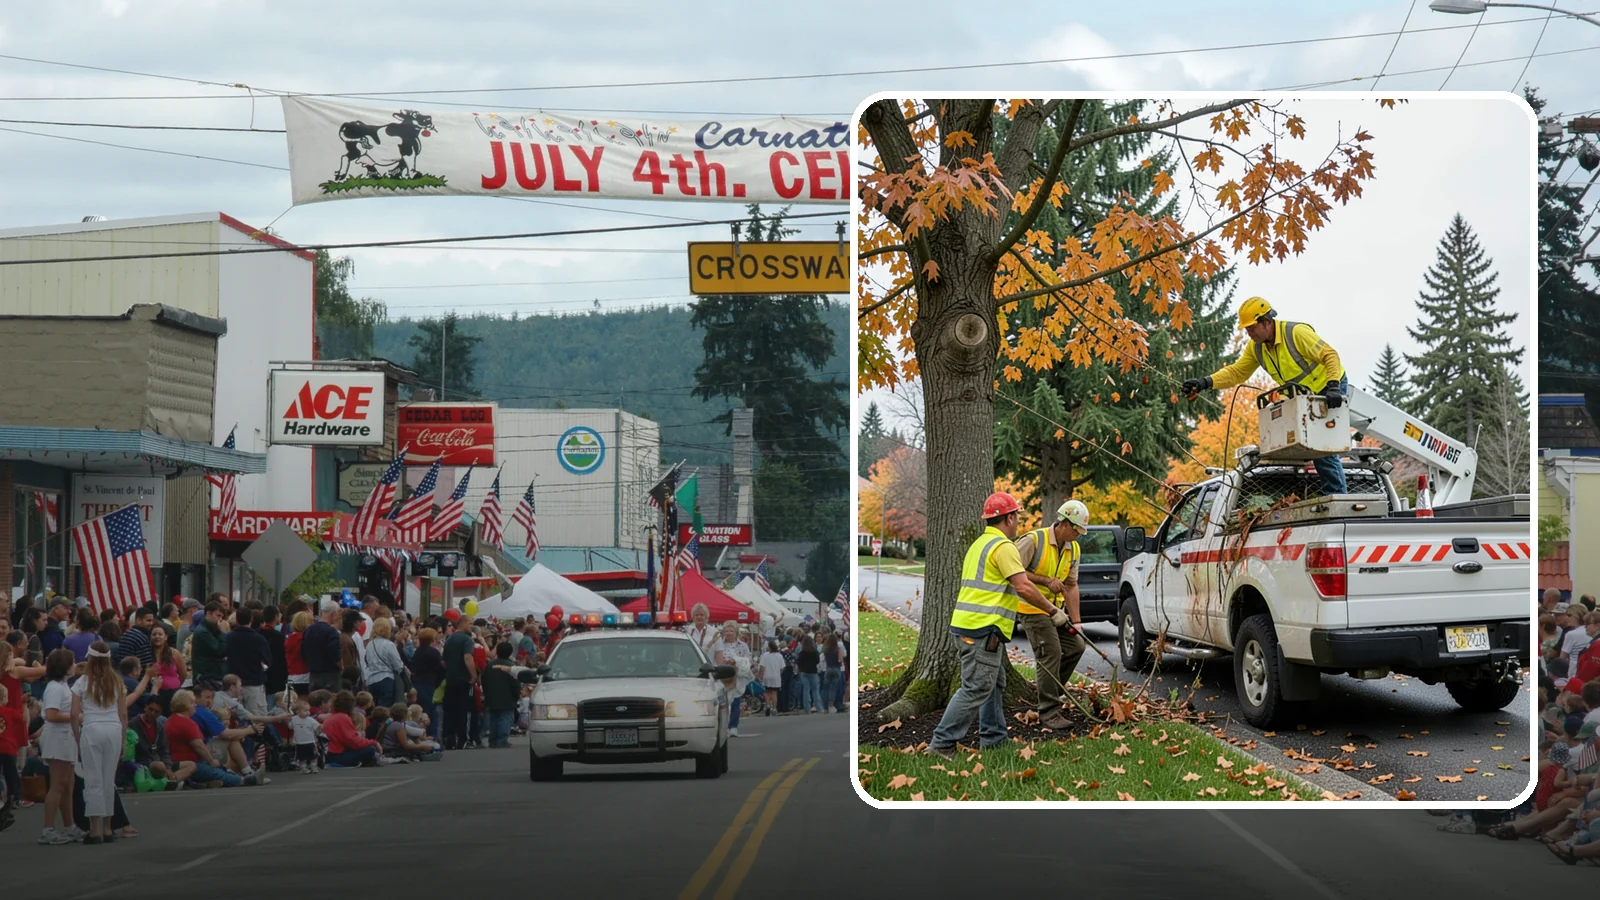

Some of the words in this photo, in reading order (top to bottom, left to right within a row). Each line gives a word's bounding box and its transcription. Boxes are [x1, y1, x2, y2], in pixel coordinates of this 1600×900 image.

[481, 140, 605, 193] JULY
[632, 150, 746, 197] 4th.
[697, 254, 850, 280] CROSSWA
[283, 380, 373, 420] ACE
[406, 409, 452, 422] CEDAR
[283, 421, 371, 437] Hardware
[416, 428, 477, 447] Coca-Cola
[95, 485, 124, 495] Vincent
[126, 486, 136, 495] de
[137, 486, 155, 495] Paul
[81, 503, 154, 522] THT
[213, 516, 331, 536] HARDARE
[688, 526, 742, 535] CRNATION
[699, 535, 730, 543] GLASS
